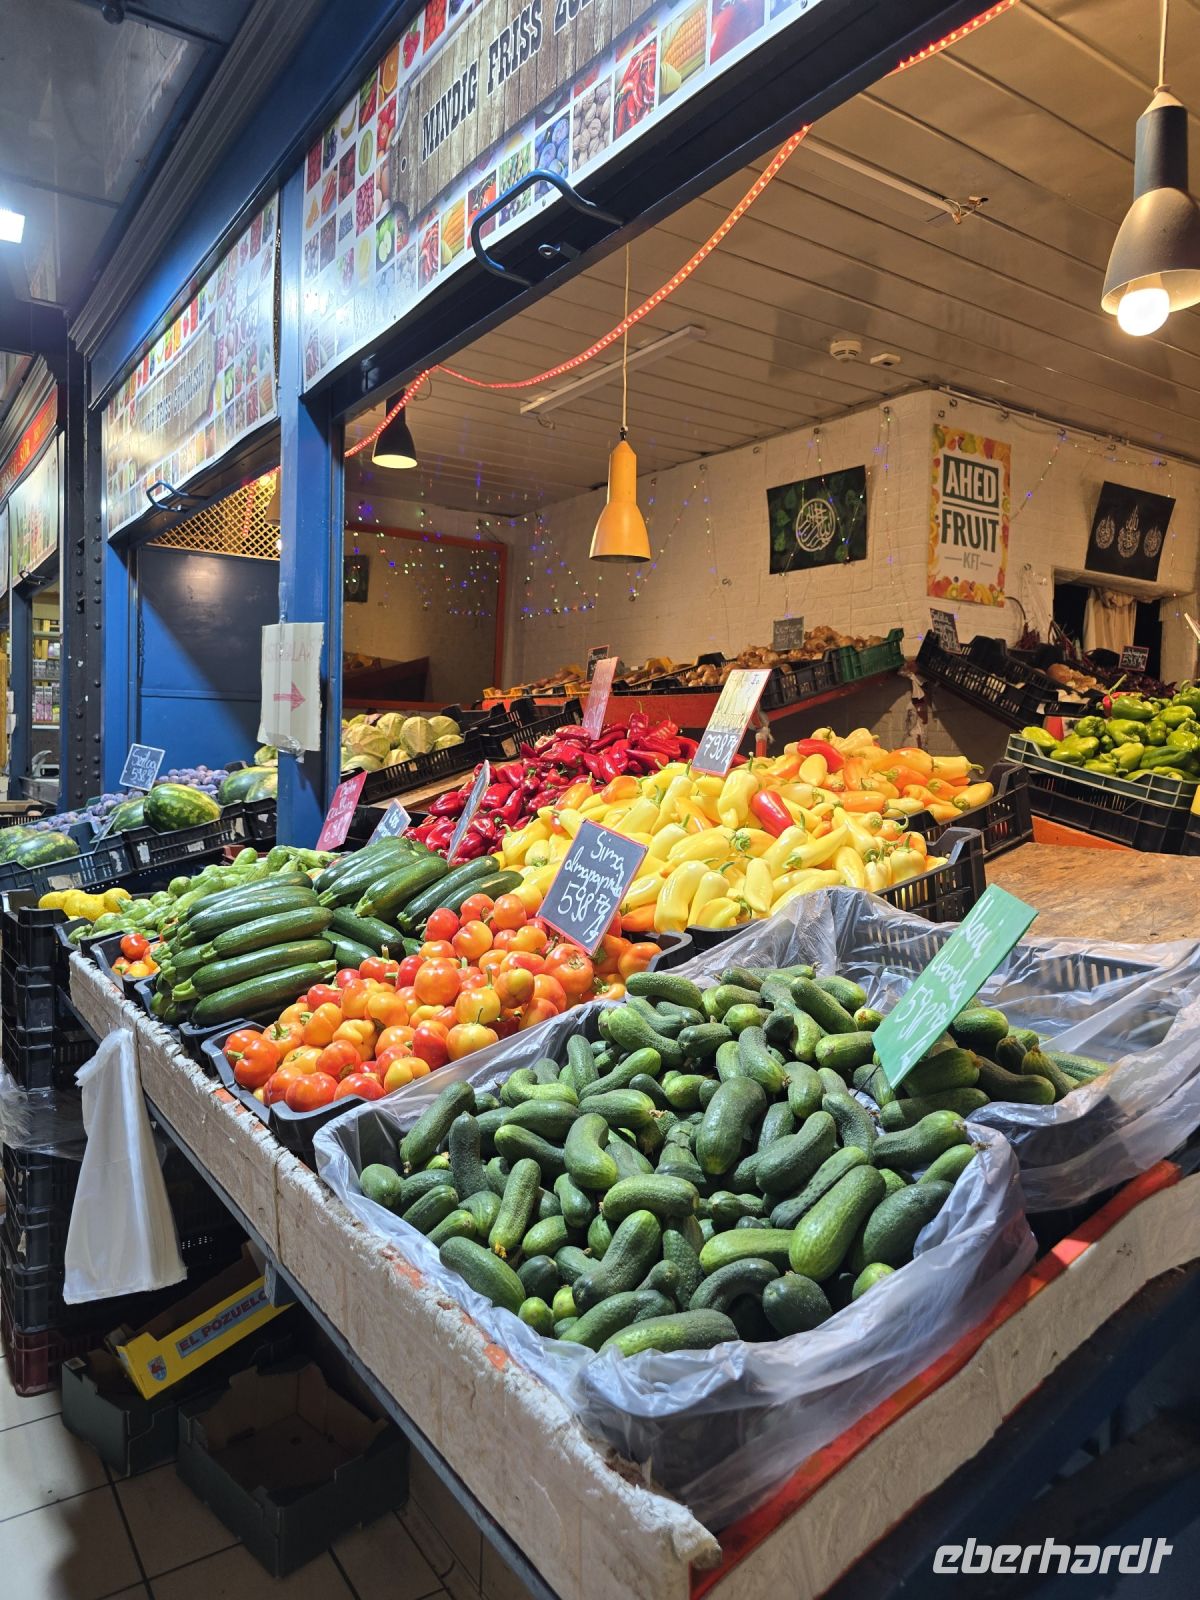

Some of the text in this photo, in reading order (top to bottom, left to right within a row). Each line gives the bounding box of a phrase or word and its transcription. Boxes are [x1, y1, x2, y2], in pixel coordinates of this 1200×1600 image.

[422, 0, 543, 165] MINDIG FRISS
[945, 460, 997, 503] AHED
[941, 508, 999, 553] FRUIT
[963, 551, 980, 571] KFT
[703, 733, 729, 761] 798
[558, 880, 594, 922] 598
[895, 983, 938, 1041] 598
[179, 1290, 267, 1350] EL POZUELO
